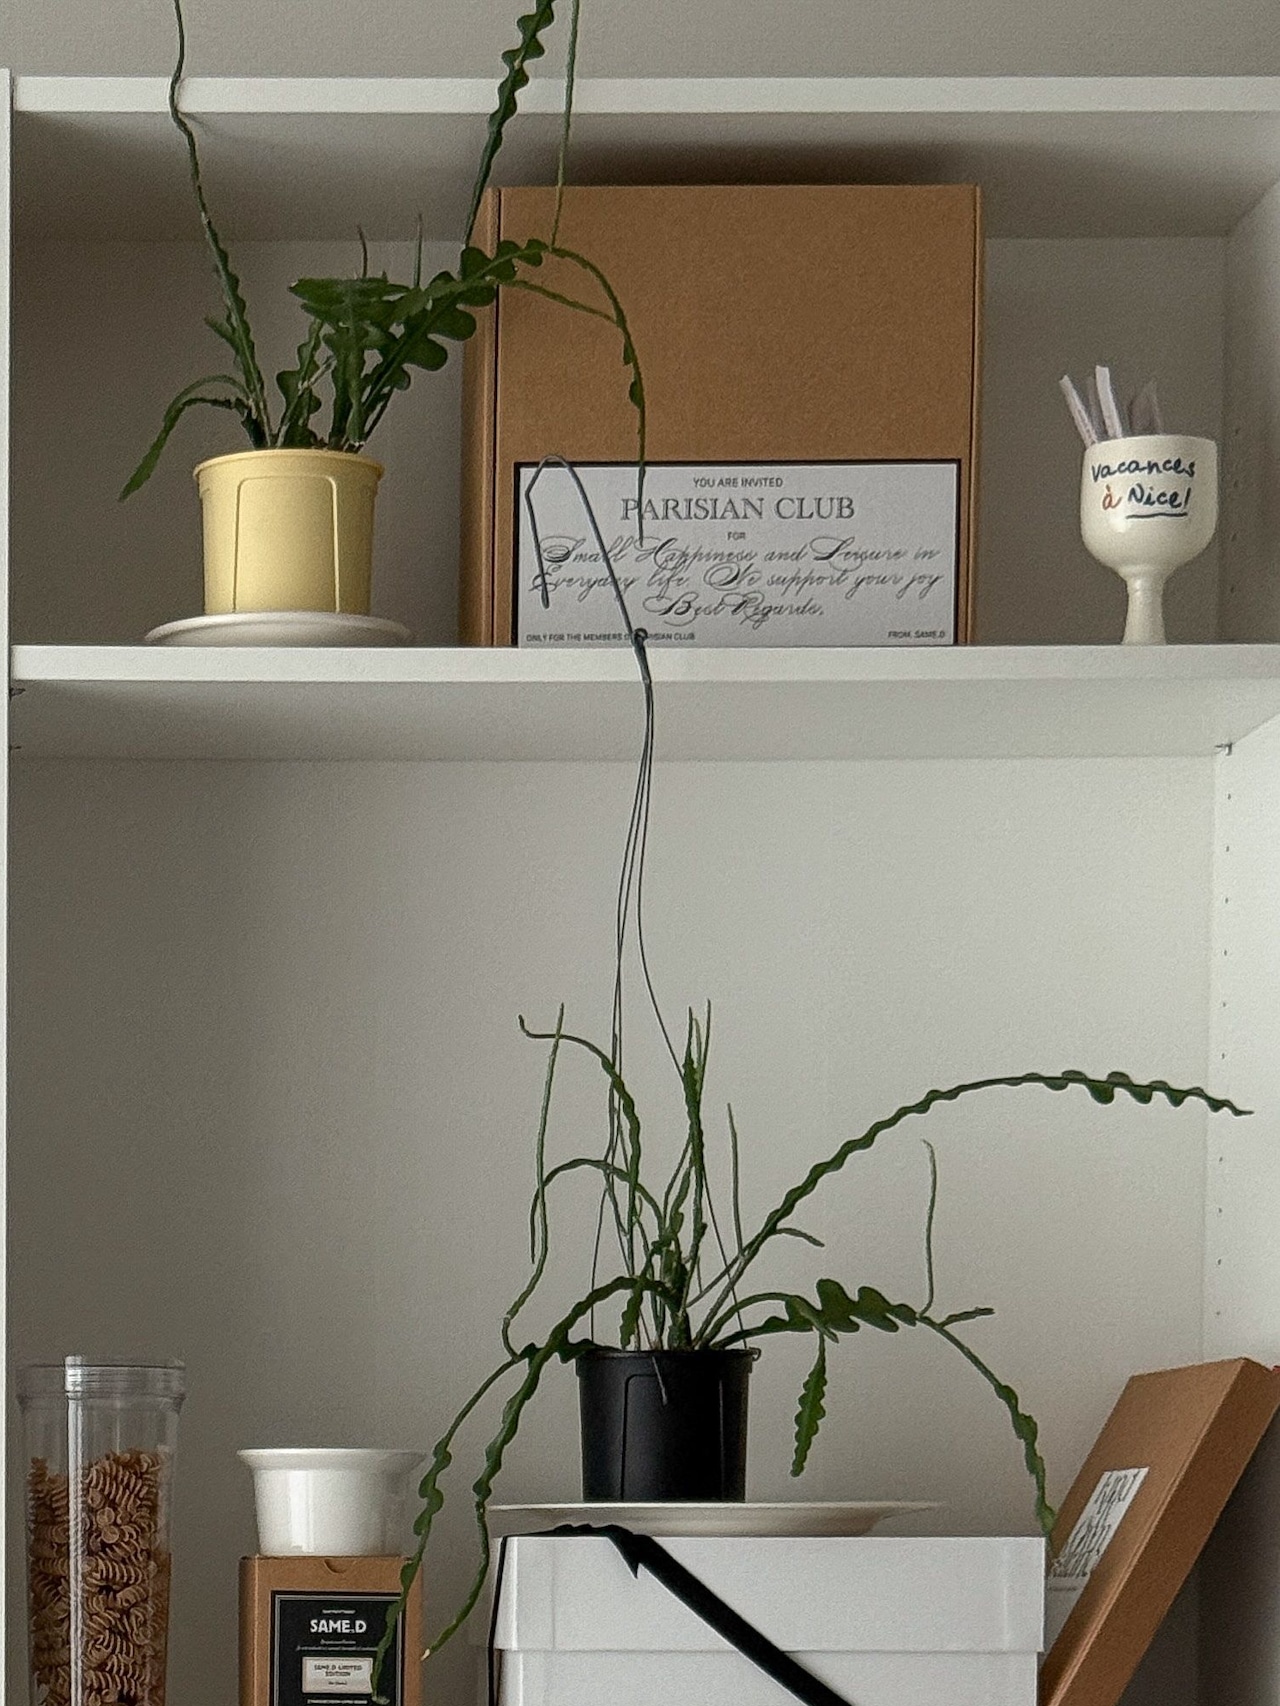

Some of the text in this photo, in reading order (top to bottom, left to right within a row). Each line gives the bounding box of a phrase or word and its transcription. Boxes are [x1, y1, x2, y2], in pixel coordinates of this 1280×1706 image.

[692, 477, 784, 488] YOU ARE INVITED
[620, 496, 856, 521] PARISIAN CLUB
[727, 531, 746, 541] FOR
[764, 543, 808, 562] and
[913, 546, 942, 561] in
[528, 564, 639, 602] Everydy
[766, 567, 850, 597] support
[843, 573, 904, 600] your
[895, 573, 944, 600] joy
[642, 591, 726, 627] Best
[525, 633, 548, 642] ONLY
[548, 633, 565, 642] FOR
[566, 633, 582, 642] THE
[583, 633, 621, 642] MEMBERS
[673, 632, 696, 641] CLUB
[309, 1618, 367, 1634] SAME.D
